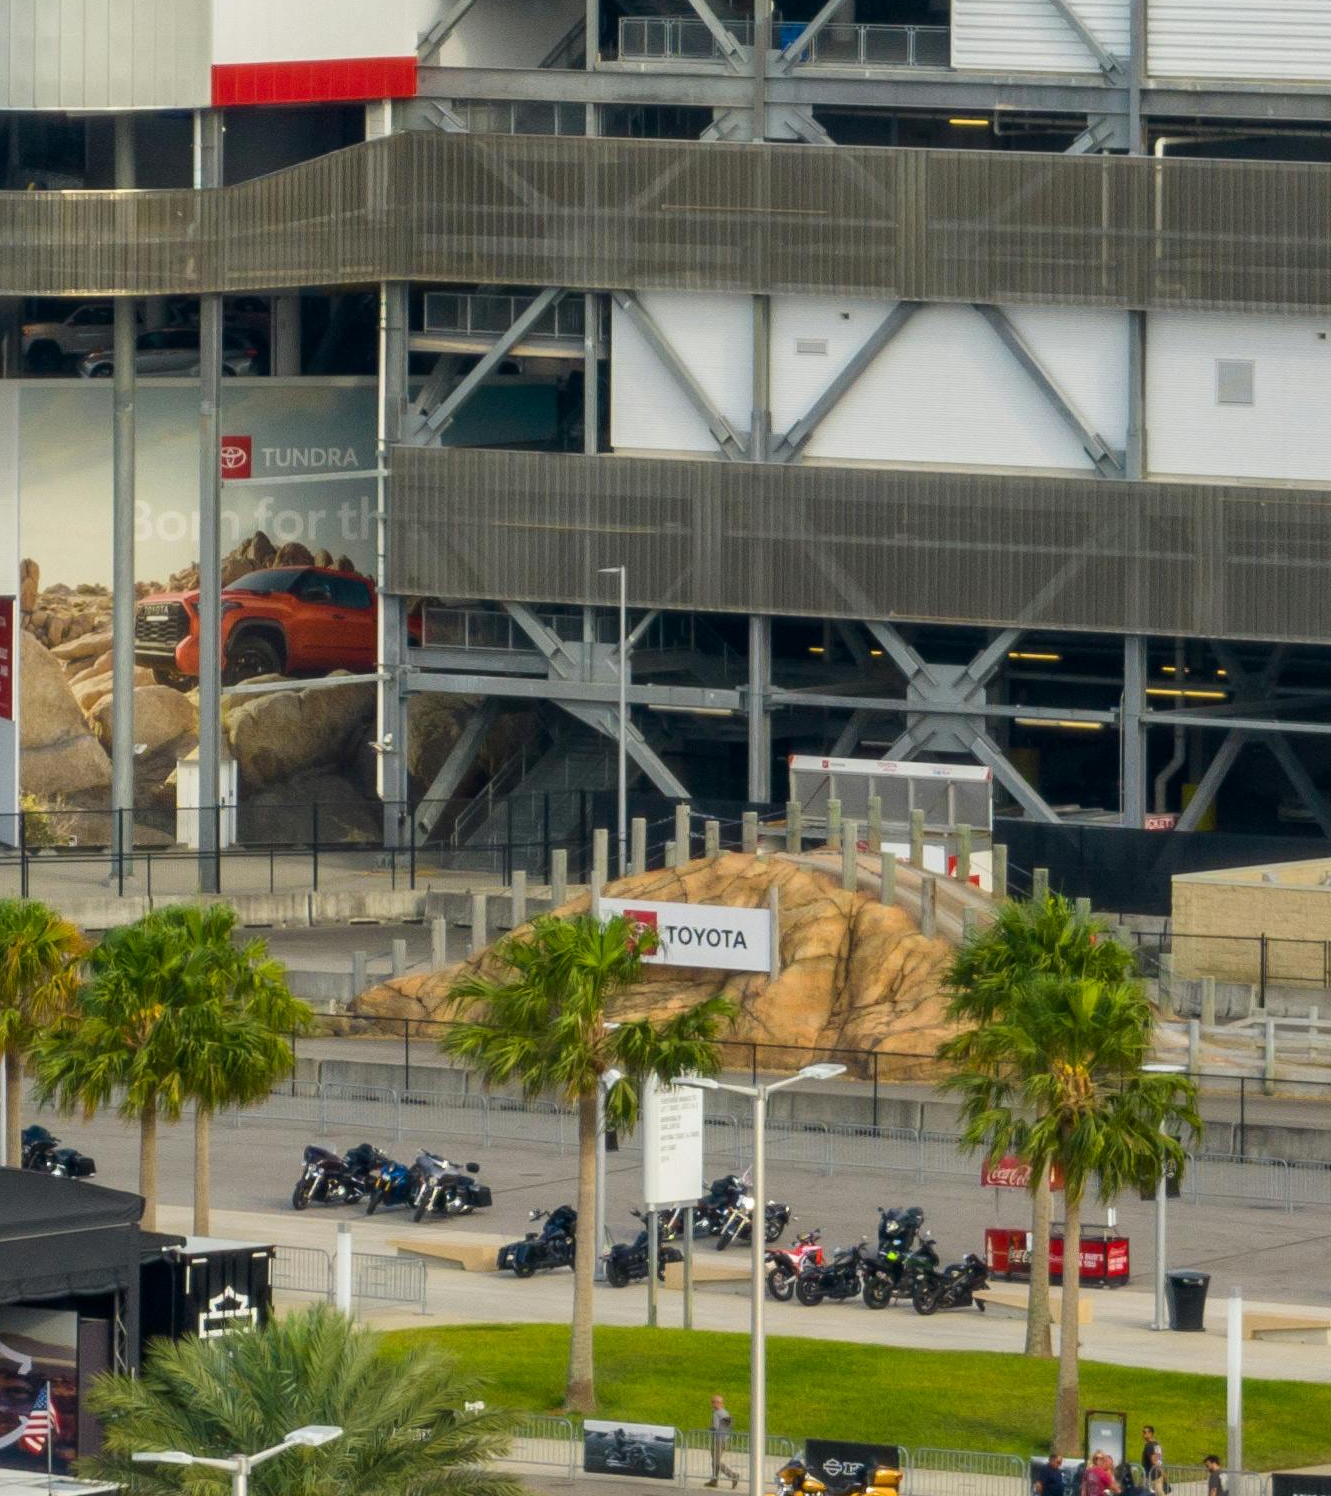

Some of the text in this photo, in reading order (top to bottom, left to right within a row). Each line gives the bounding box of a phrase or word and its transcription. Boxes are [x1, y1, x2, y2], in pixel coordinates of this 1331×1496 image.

[261, 447, 359, 467] TUNDRA
[251, 495, 327, 542] for
[666, 924, 748, 950] TOYOTA
